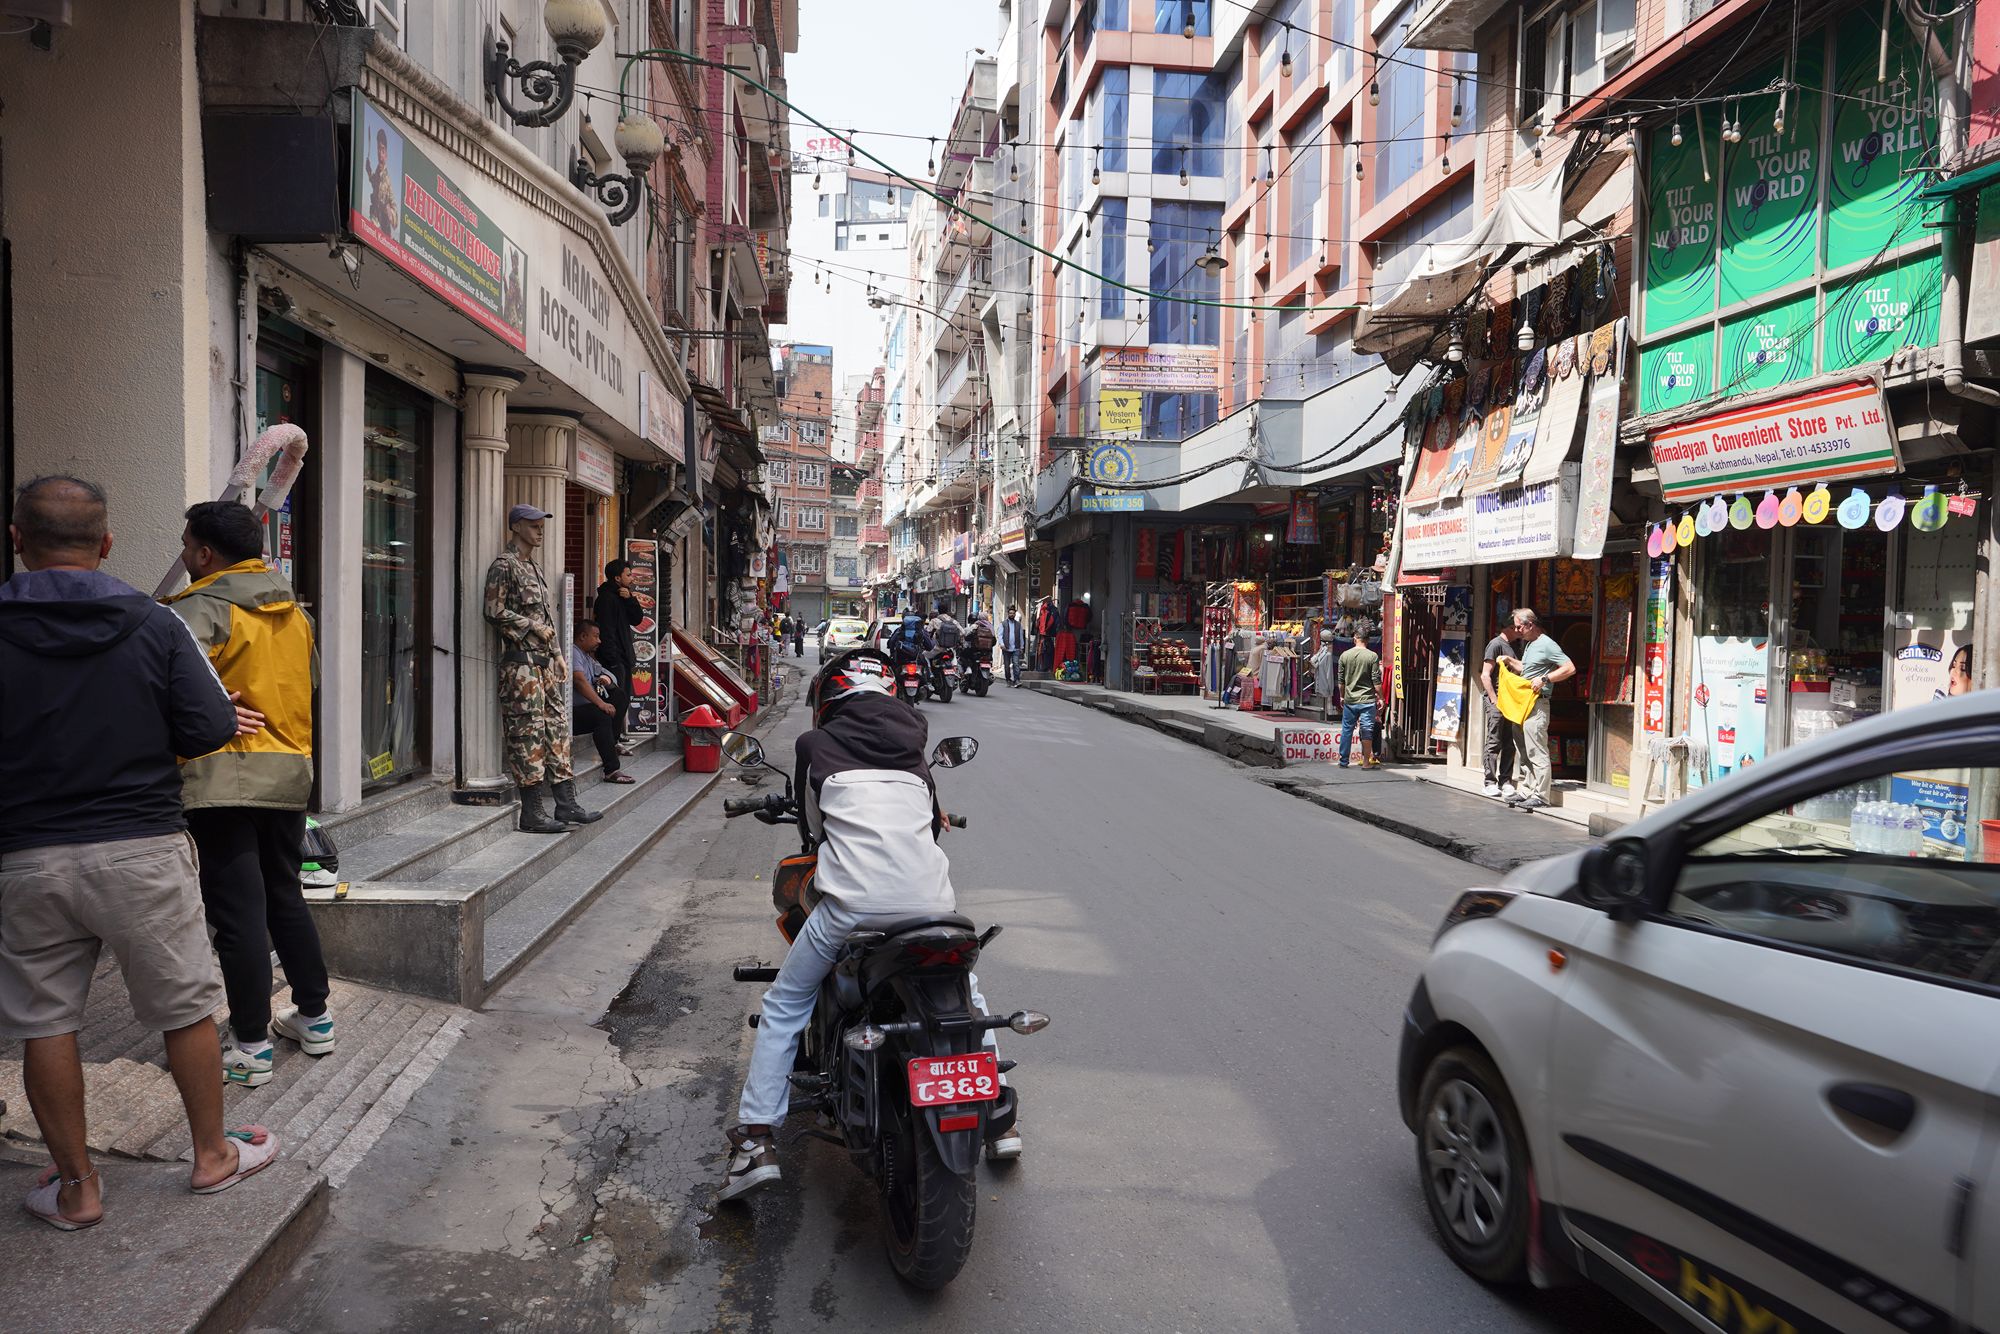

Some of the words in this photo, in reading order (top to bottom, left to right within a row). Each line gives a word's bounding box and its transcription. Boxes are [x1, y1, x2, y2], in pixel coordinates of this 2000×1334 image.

[1858, 80, 1901, 111] TILT
[1867, 96, 1934, 132] YOUR
[1748, 132, 1784, 159] TILT
[1841, 125, 1922, 163] WORLD
[1756, 148, 1811, 179] YOUR
[437, 174, 479, 229] Himalayan
[1665, 185, 1695, 208] TILT
[1734, 174, 1805, 208] WORLD
[1671, 202, 1714, 227] YOUR
[404, 173, 466, 254] KHUKURI
[465, 228, 501, 284] HOUSE
[1655, 224, 1710, 249] WORLD
[446, 265, 475, 295] Wholesaler
[480, 290, 499, 312] Retailer
[1864, 288, 1891, 304] TILT
[1869, 302, 1909, 318] YOUR
[540, 286, 582, 363] HOTEL
[1755, 324, 1775, 340] TILT
[1854, 316, 1905, 334] WORLD
[1759, 336, 1791, 351] YOUR
[1118, 351, 1140, 363] Asian
[1143, 352, 1176, 365] Heritage
[1666, 351, 1684, 366] TILT
[1669, 360, 1695, 376] YOUR
[1747, 348, 1787, 365] WORLD
[1660, 373, 1693, 388] WORLD
[1653, 438, 1709, 466] Himalayan
[1712, 420, 1783, 452] Convenient
[1788, 414, 1828, 440] Store
[1836, 416, 1858, 431] Pvt.
[1863, 407, 1885, 426] Ltd.
[1682, 462, 1710, 476] Thamel,
[1710, 455, 1754, 472] Kathmandu,
[1755, 450, 1781, 465] Nepal,
[1781, 447, 1796, 460] Tel:
[1797, 437, 1851, 457] 01-4533976
[1083, 498, 1124, 508] DISTRICT
[1127, 497, 1144, 508] 350
[1475, 492, 1500, 514] UNIQUE
[1500, 486, 1529, 510] ARTISTIC
[1530, 482, 1546, 505] LANE
[1405, 525, 1421, 540] UNIQUE
[1422, 523, 1437, 538] MONEY
[1439, 518, 1462, 536] EXCHANGE
[1394, 646, 1402, 690] CARGO
[1734, 659, 1748, 669] your
[1748, 657, 1760, 668] lips
[1900, 664, 1929, 673] Cookies
[1911, 673, 1936, 682] Cream
[1284, 732, 1320, 745] CARGO
[1322, 733, 1332, 746] &
[917, 1076, 994, 1102] ८३६२
